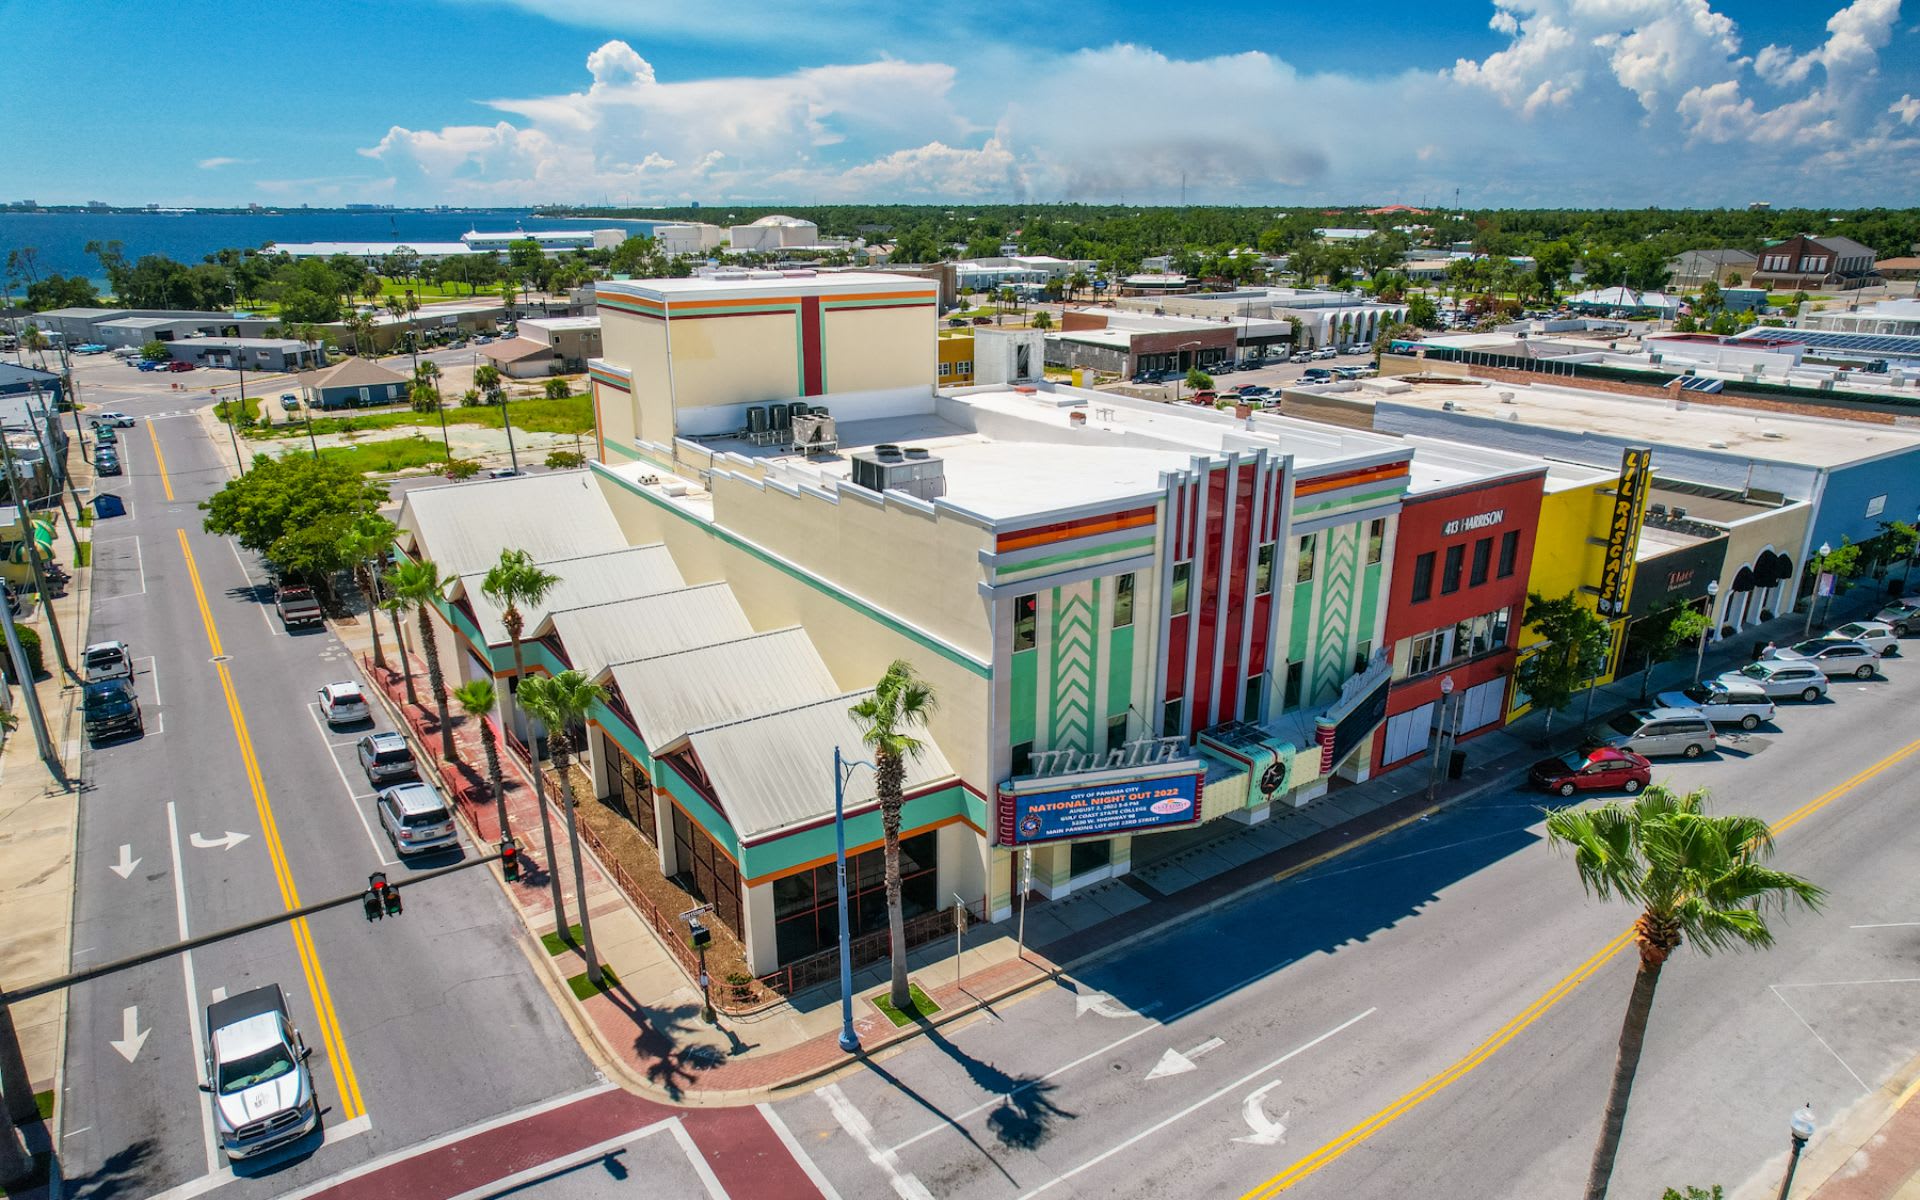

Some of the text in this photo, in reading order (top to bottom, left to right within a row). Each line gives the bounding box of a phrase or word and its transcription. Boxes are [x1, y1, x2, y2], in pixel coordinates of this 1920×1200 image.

[1444, 509, 1504, 535] 413 HARRISON
[1600, 452, 1637, 599] LIL RASCALS
[1618, 452, 1650, 599] BILLIARDS
[1028, 788, 1179, 813] NATIONAL NIGHT OUT 2022
[1096, 788, 1124, 796] PANAMA
[1060, 814, 1077, 822] GULF
[1078, 812, 1099, 820] COAST
[1099, 809, 1119, 817] STATE
[1119, 806, 1147, 815] COLLEGE
[1069, 805, 1095, 814] AUGUST
[1065, 824, 1093, 833] PARKING
[1137, 816, 1160, 824] STREET
[1096, 814, 1127, 823] HIGHWAY
